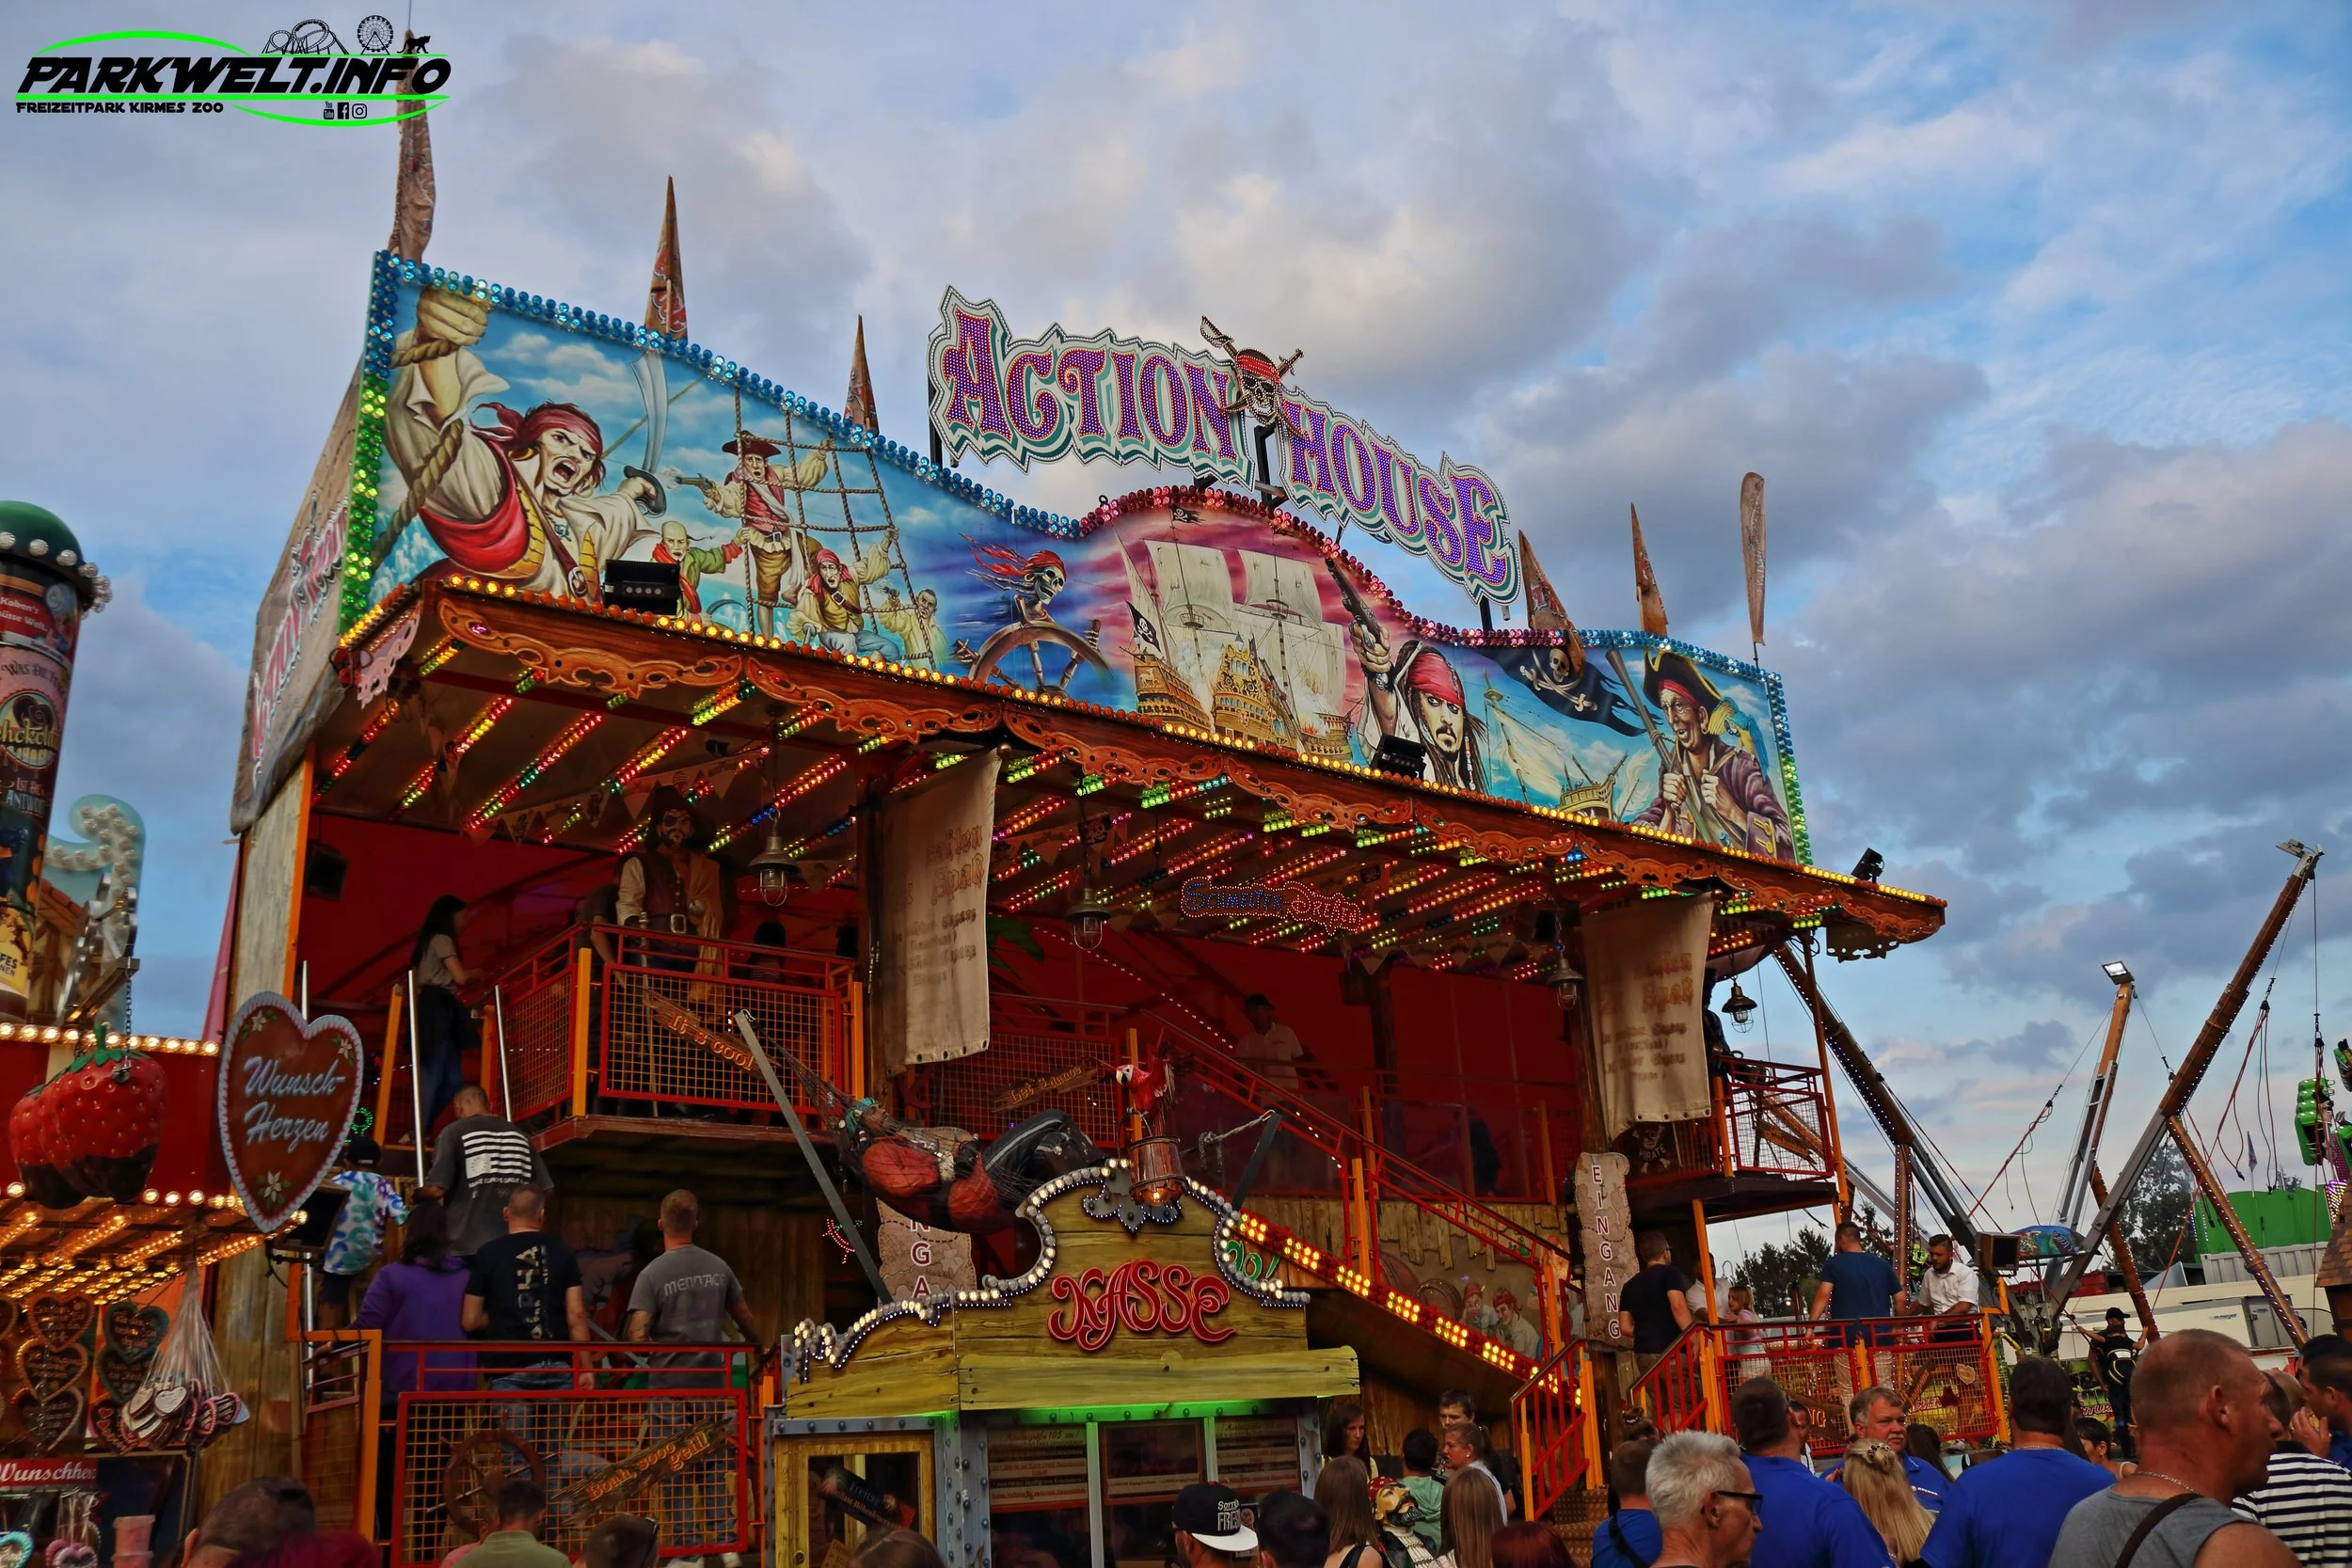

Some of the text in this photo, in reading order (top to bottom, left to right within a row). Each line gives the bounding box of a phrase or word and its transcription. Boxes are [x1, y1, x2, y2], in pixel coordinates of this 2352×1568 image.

[941, 308, 1510, 587] ACTION HOUSE
[243, 1055, 346, 1097] Wunsch-
[243, 1101, 329, 1154] Herzen
[1591, 1164, 1622, 1339] EINGANG
[1047, 1259, 1237, 1352] KASSE
